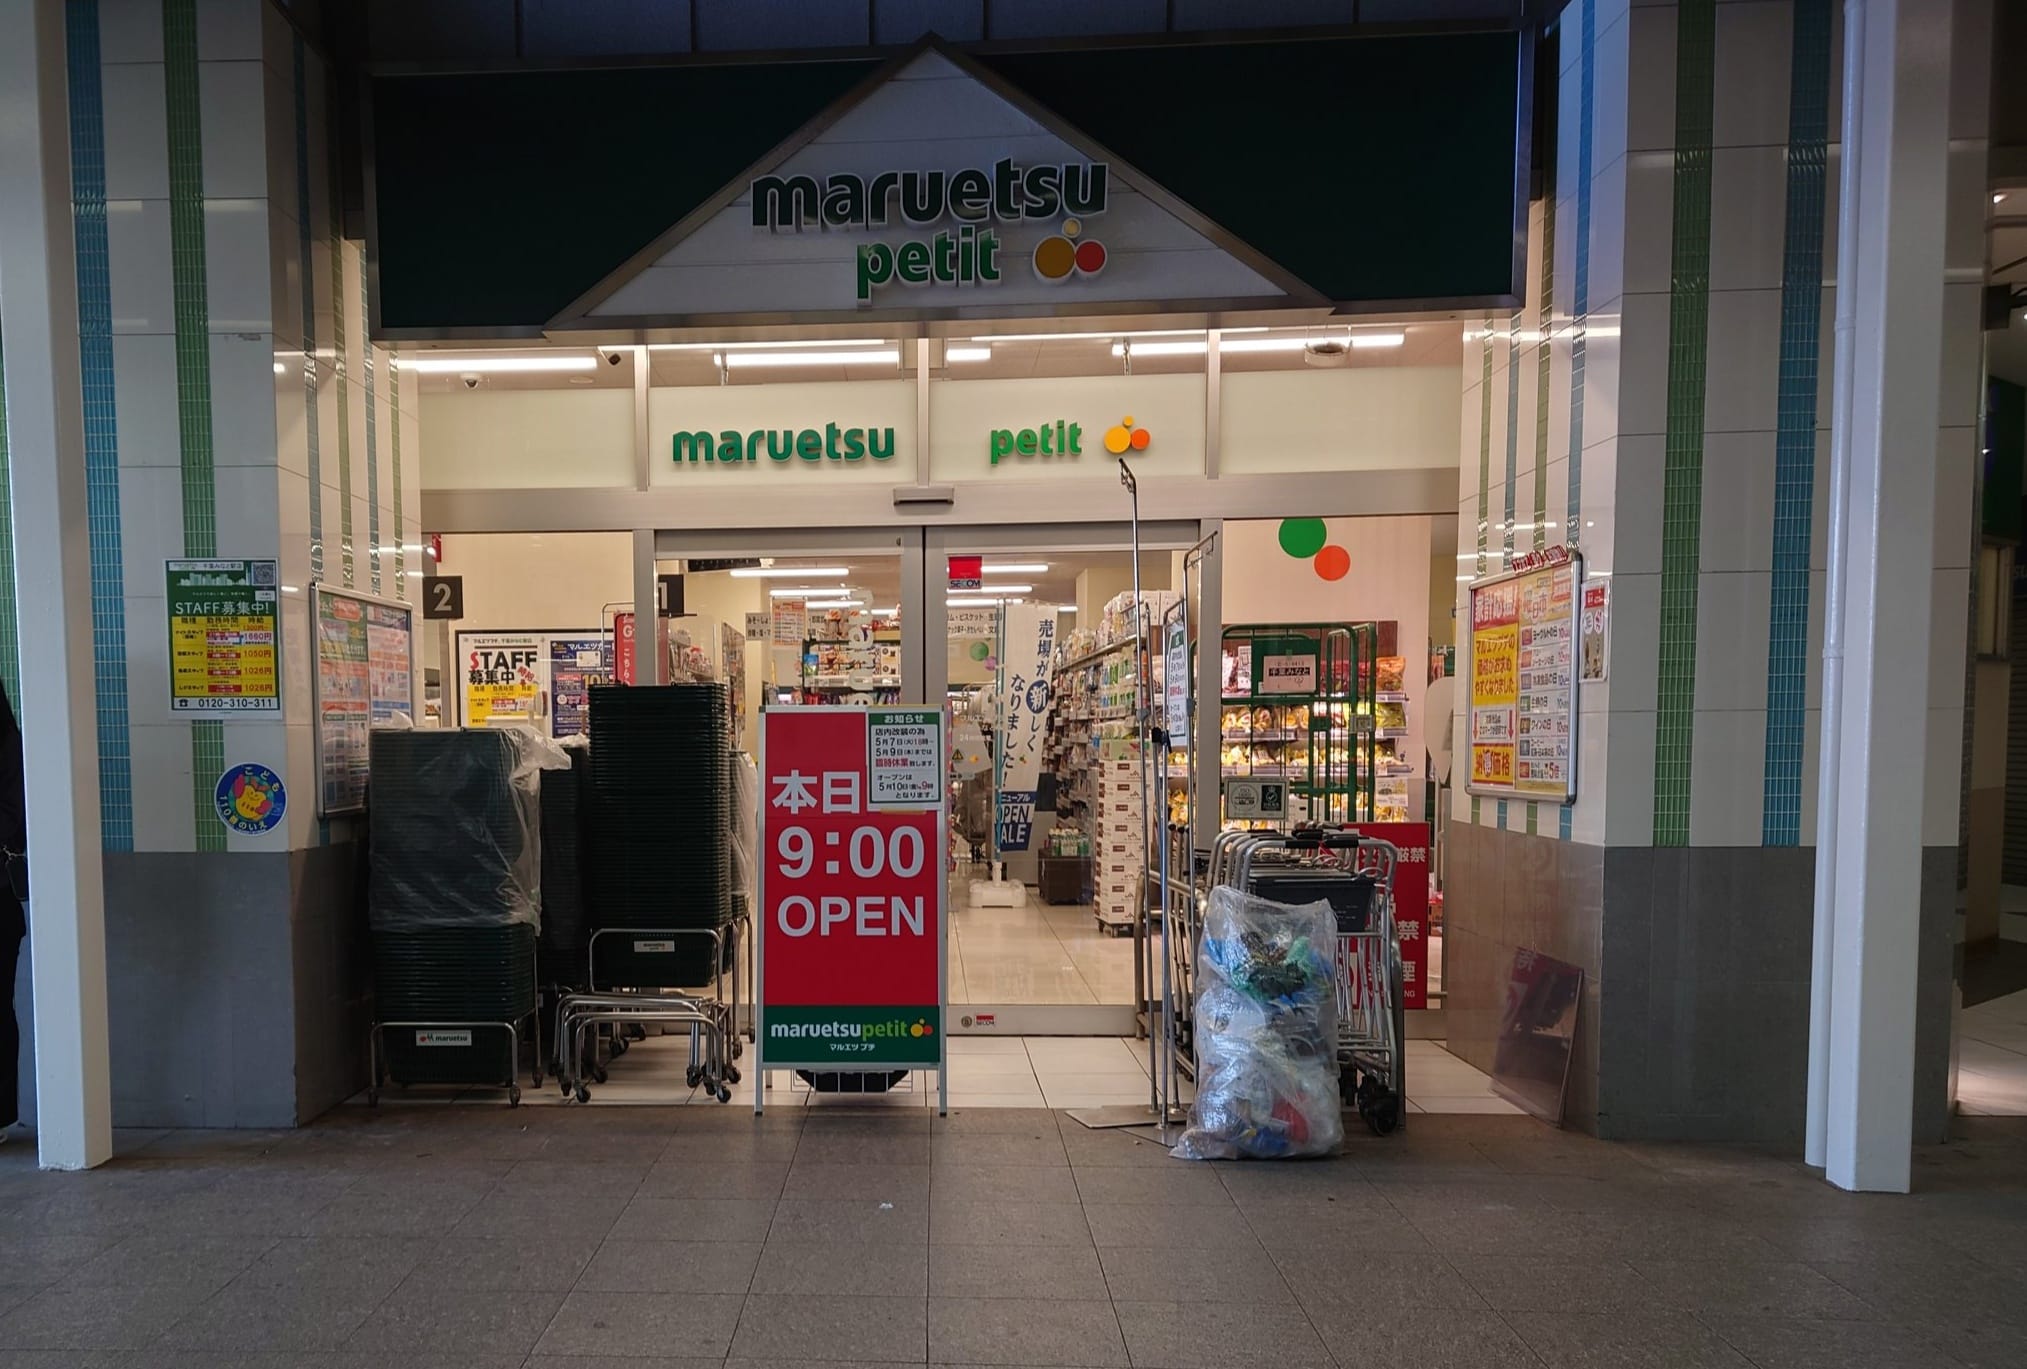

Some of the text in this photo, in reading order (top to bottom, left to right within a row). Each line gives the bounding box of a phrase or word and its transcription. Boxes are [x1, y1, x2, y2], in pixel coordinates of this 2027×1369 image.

[751, 157, 1109, 230] maruetsu
[857, 225, 1000, 303] petit
[673, 419, 1082, 464] maruetsu petit
[433, 583, 452, 611] 2
[468, 668, 515, 685] 募集中
[470, 651, 538, 670] STAFF
[198, 698, 272, 708] 0120-310-311
[884, 714, 924, 724] お知らせ
[1001, 674, 1026, 788] なりました!
[245, 767, 280, 792] こども
[772, 770, 860, 814] 本日
[778, 826, 925, 878] 9:00
[778, 895, 924, 937] OPEN
